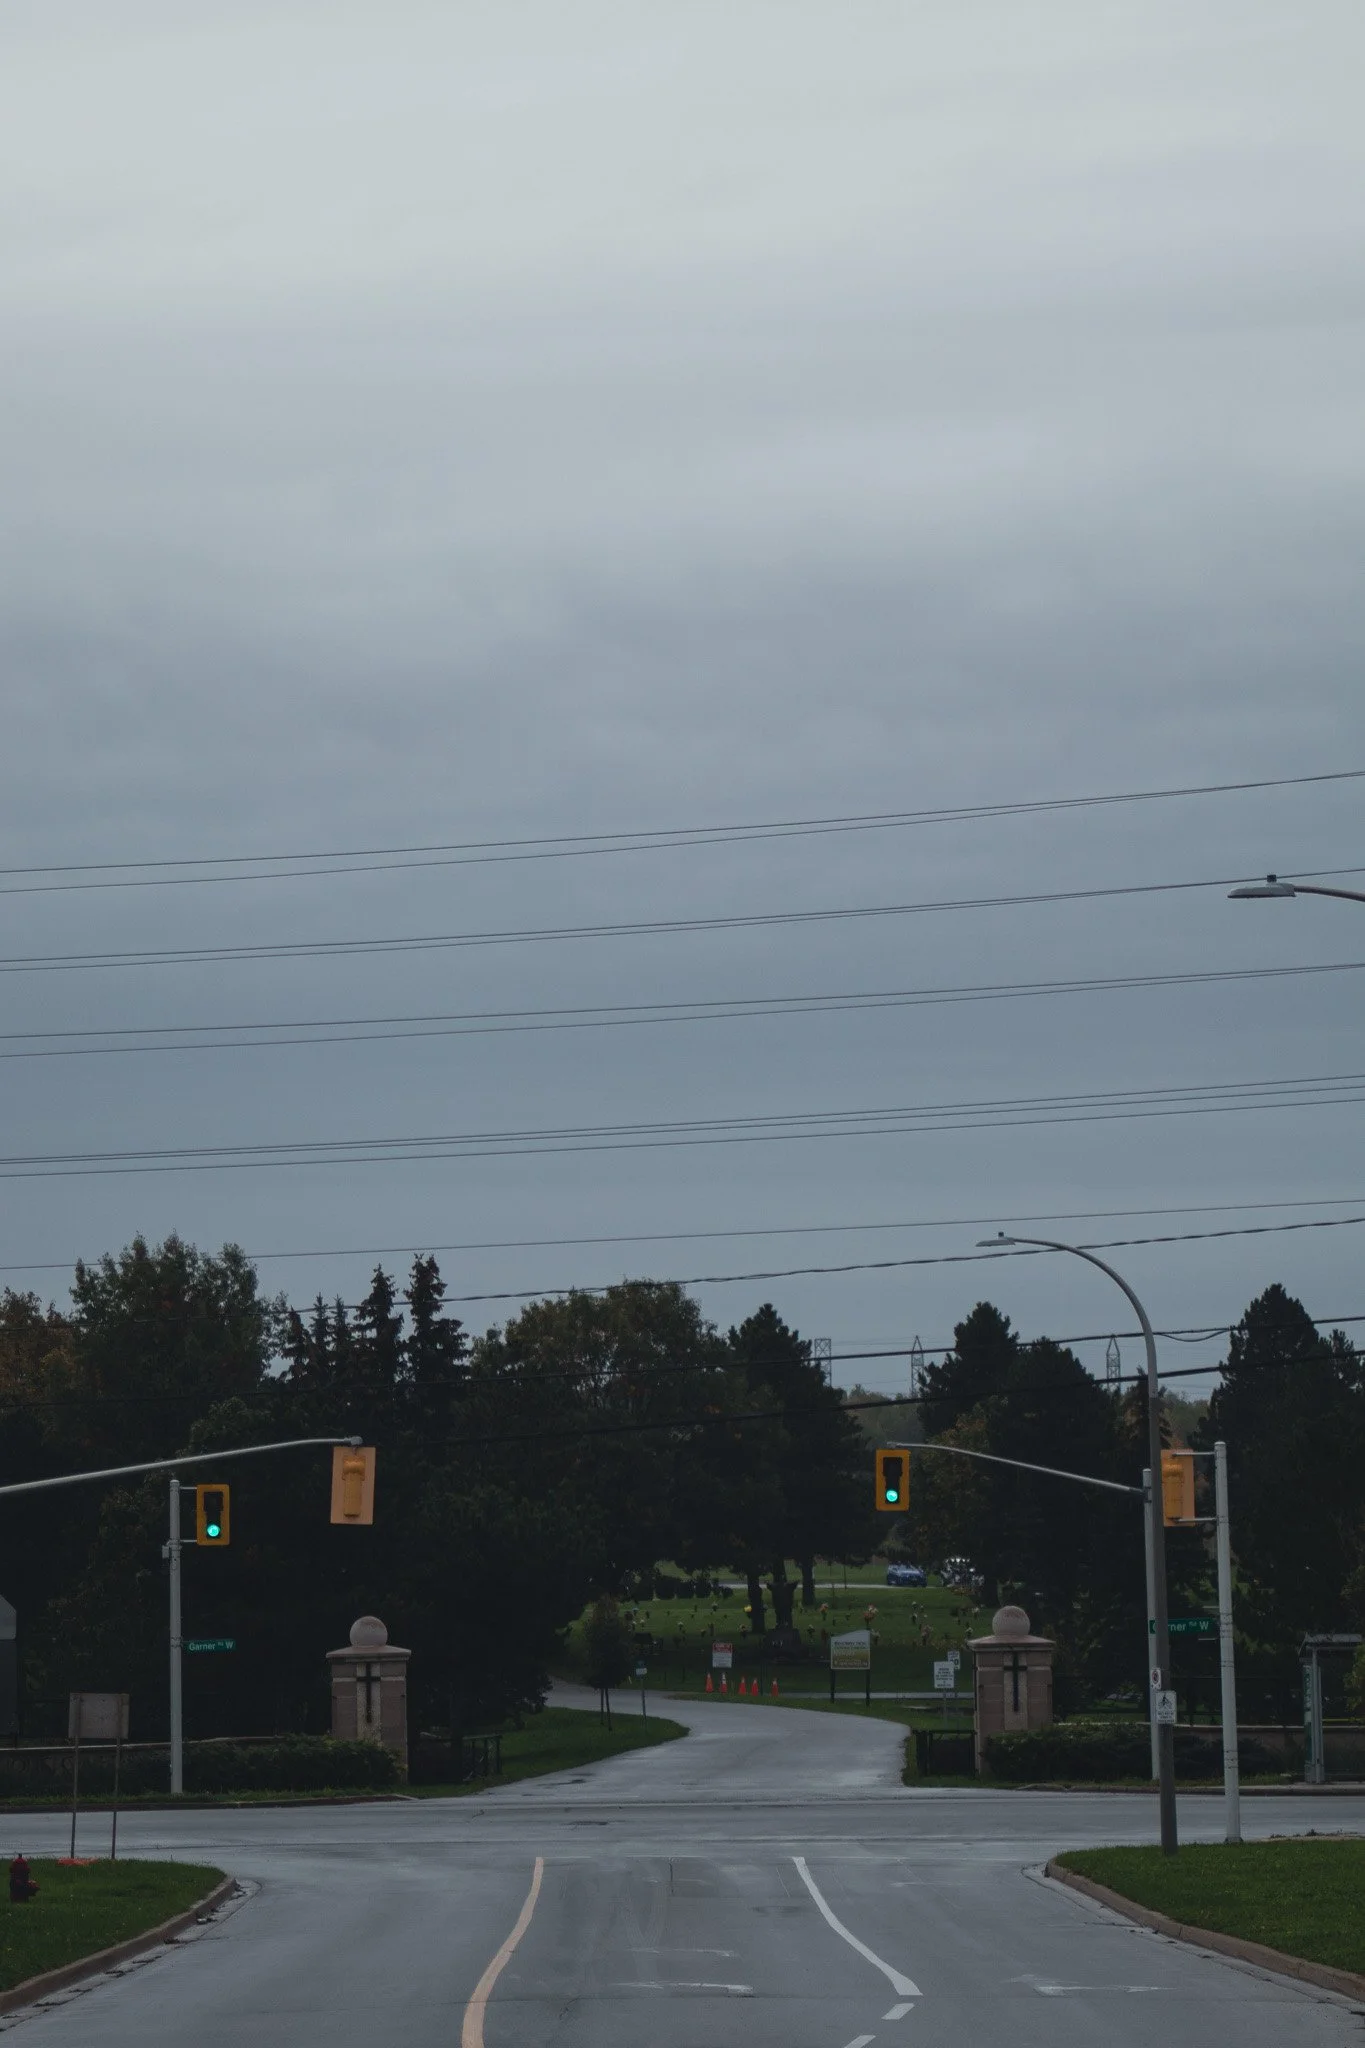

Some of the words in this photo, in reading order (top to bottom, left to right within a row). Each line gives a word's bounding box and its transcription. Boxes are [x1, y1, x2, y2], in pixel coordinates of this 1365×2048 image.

[1199, 1620, 1209, 1630] W
[189, 1642, 216, 1651] Garner
[225, 1641, 234, 1649] W
